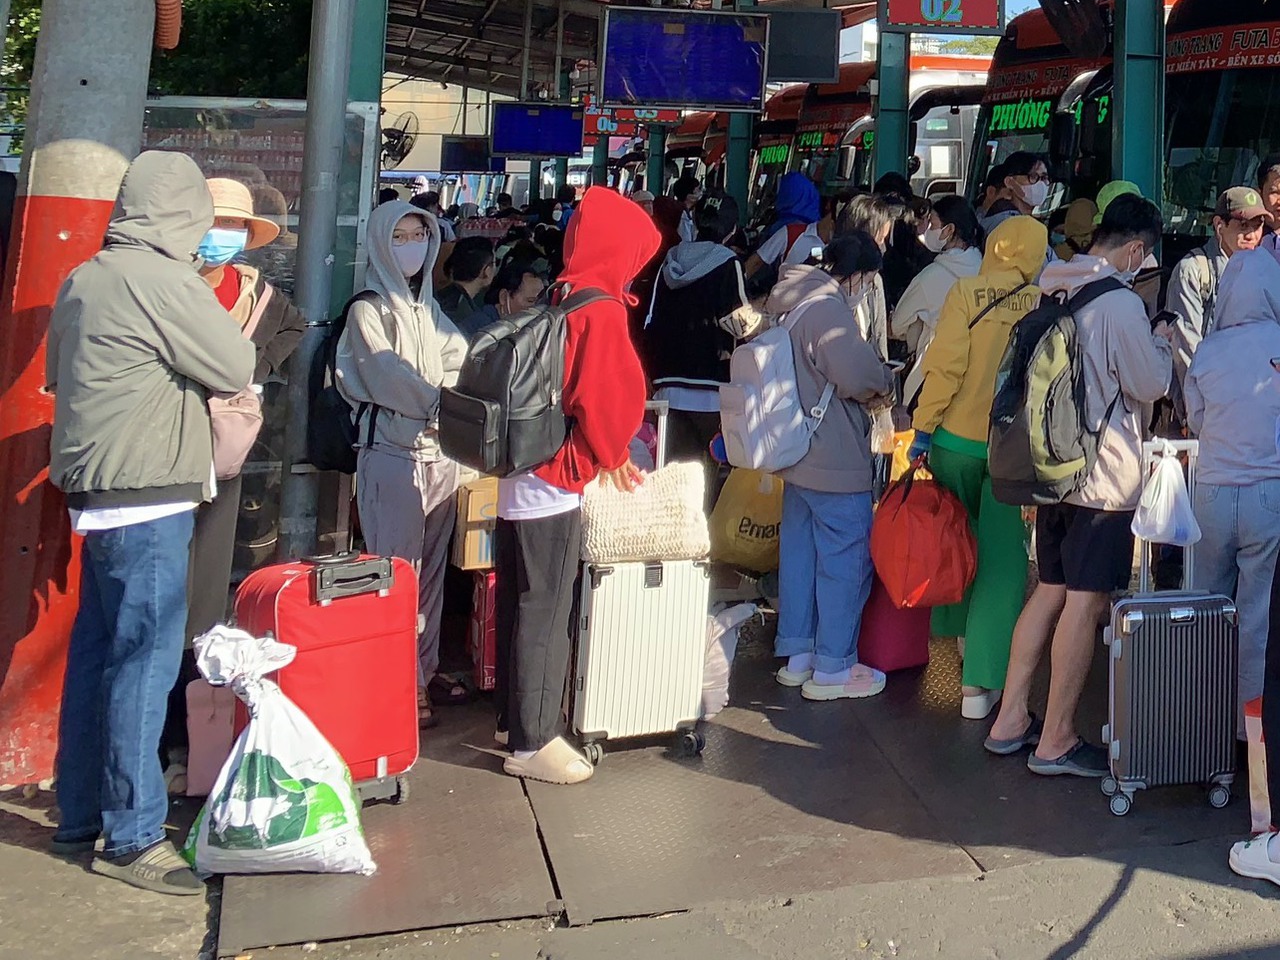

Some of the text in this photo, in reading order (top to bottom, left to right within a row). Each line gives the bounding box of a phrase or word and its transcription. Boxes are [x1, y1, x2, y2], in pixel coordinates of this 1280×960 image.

[1230, 28, 1269, 52] FUTA
[1250, 54, 1265, 66] XE
[988, 97, 1052, 131] PHƯƠNG
